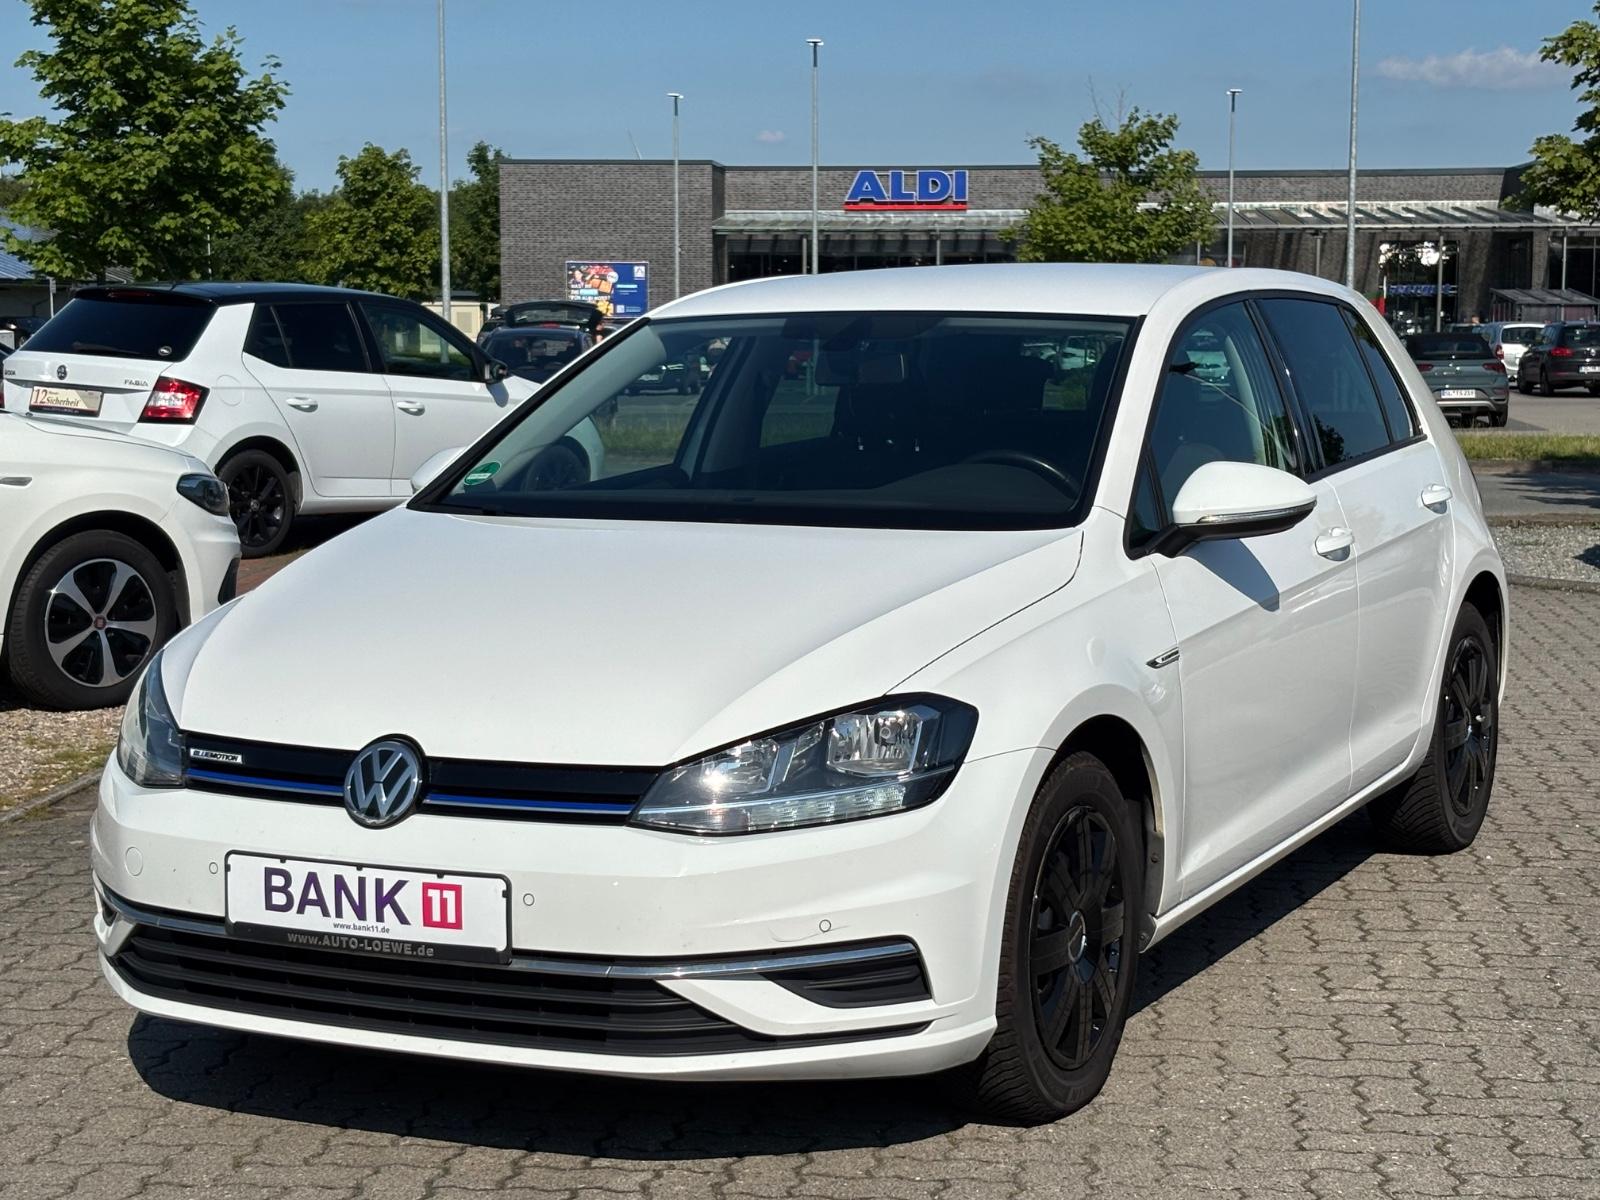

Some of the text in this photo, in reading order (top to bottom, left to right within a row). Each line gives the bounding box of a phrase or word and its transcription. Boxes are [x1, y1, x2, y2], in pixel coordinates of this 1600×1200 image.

[845, 170, 968, 202] ALDI
[33, 388, 48, 404] 12
[46, 396, 80, 407] Sicherheit
[193, 750, 239, 762] BLUEMOTION
[263, 866, 457, 926] BANK 11
[332, 920, 391, 934] www.bank11.de
[287, 931, 435, 957] www.AUTO-LOEWE.de
